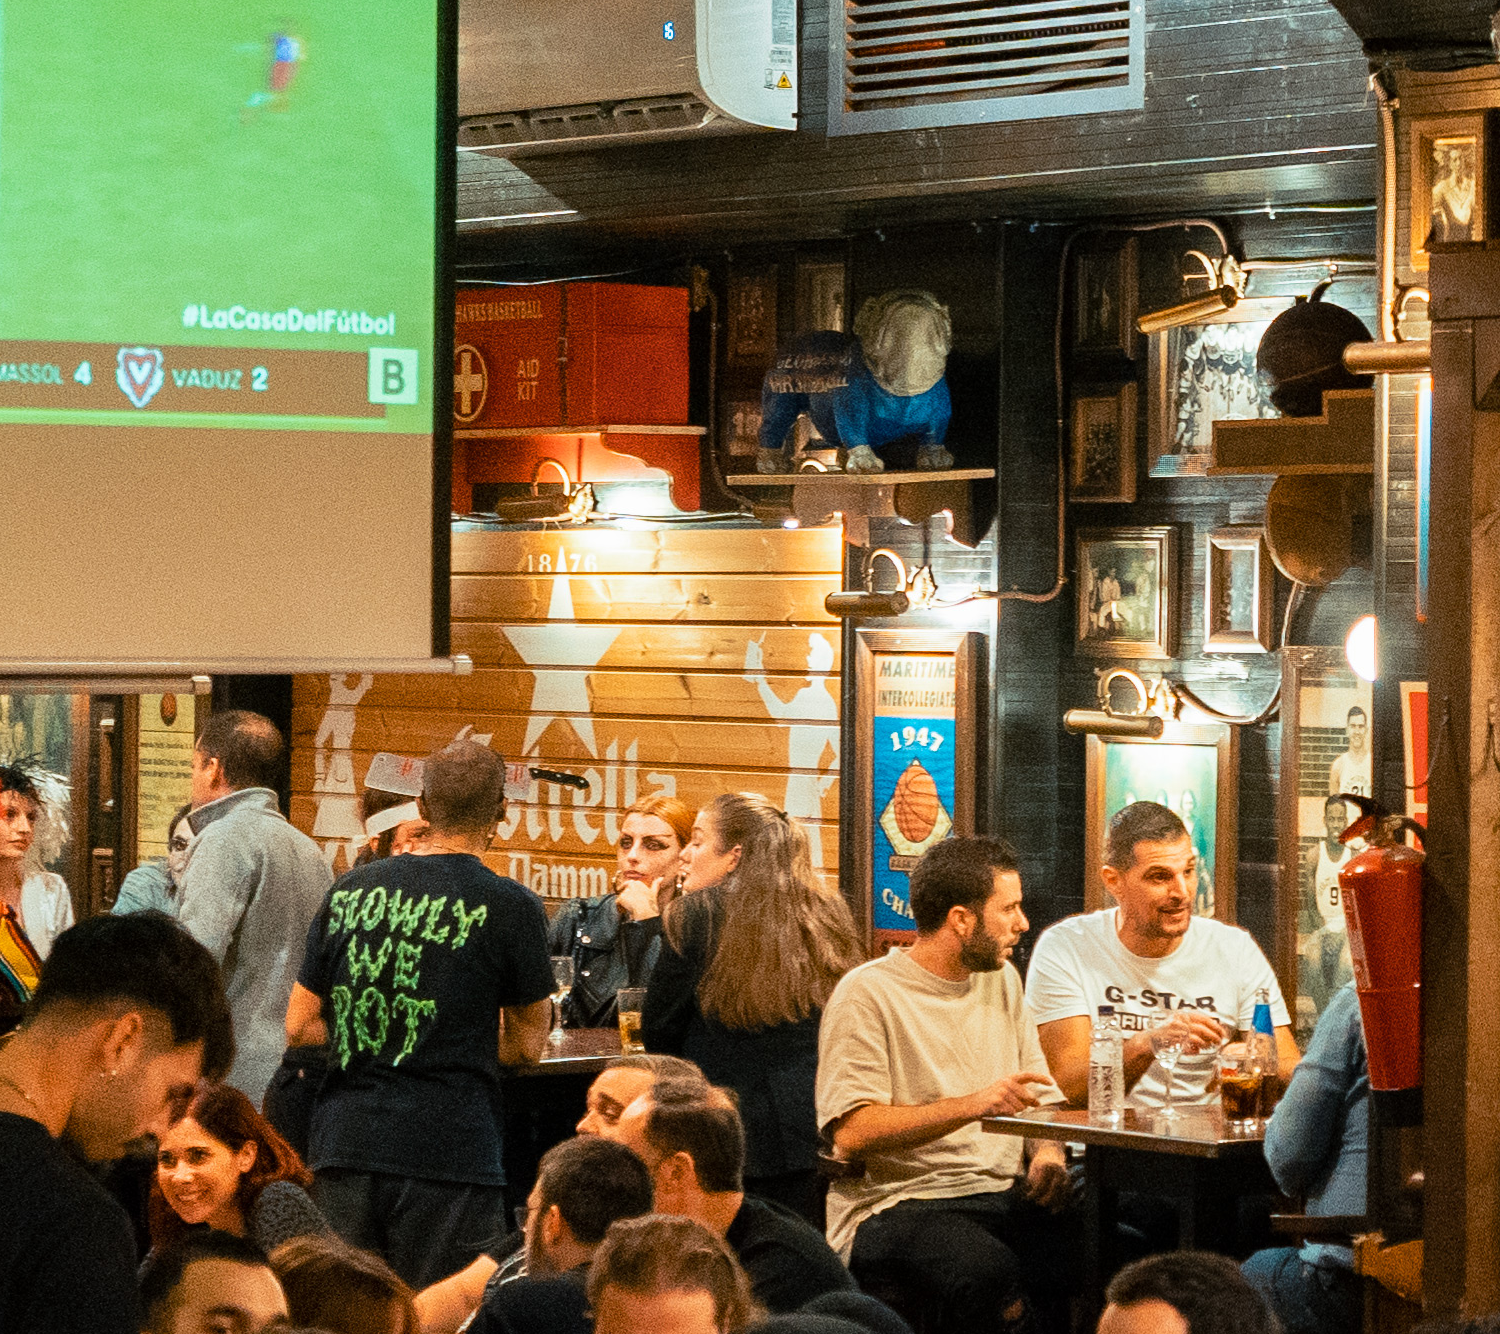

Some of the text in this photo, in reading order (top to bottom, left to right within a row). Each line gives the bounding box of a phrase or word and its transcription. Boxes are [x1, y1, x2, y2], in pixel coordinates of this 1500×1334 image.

[74, 360, 92, 385] 4
[172, 367, 243, 391] VADUZ
[251, 367, 268, 391] 2
[382, 358, 405, 394] B
[517, 359, 540, 378] AID
[518, 382, 538, 400] KIT
[879, 661, 955, 678] MARITIME
[890, 726, 944, 752] 1947
[508, 853, 607, 897] Damm
[328, 885, 488, 949] SLOWLY
[347, 935, 423, 989] WE
[1105, 986, 1218, 1012] G-STAR
